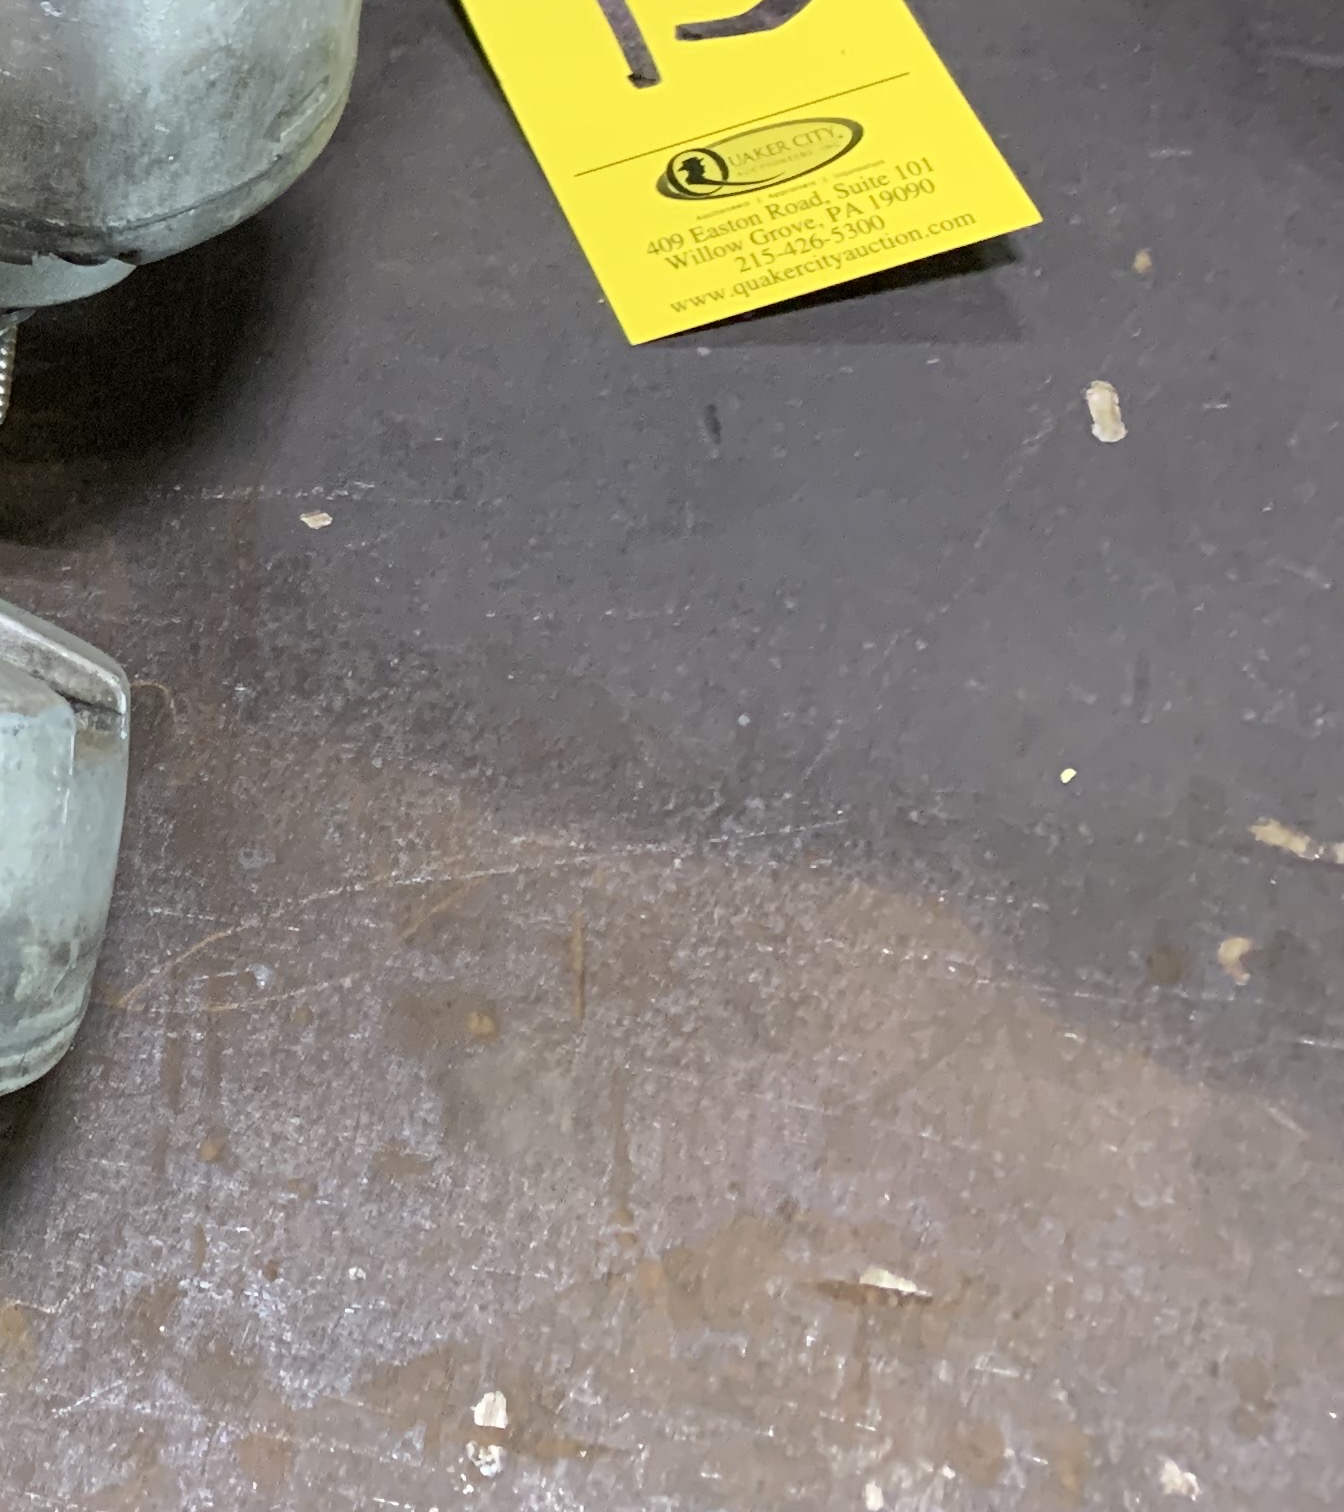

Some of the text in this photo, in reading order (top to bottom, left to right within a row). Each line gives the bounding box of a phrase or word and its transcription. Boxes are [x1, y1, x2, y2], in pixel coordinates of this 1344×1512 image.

[642, 230, 688, 258] 409
[687, 207, 763, 244] Easton
[763, 187, 831, 221] Road,
[830, 168, 891, 201] Suite
[893, 155, 935, 181] 101
[664, 176, 938, 273] Willow Grove, PA 19090
[732, 212, 888, 274] 215-426-5300
[667, 207, 979, 319] www.quakercityauction.com
